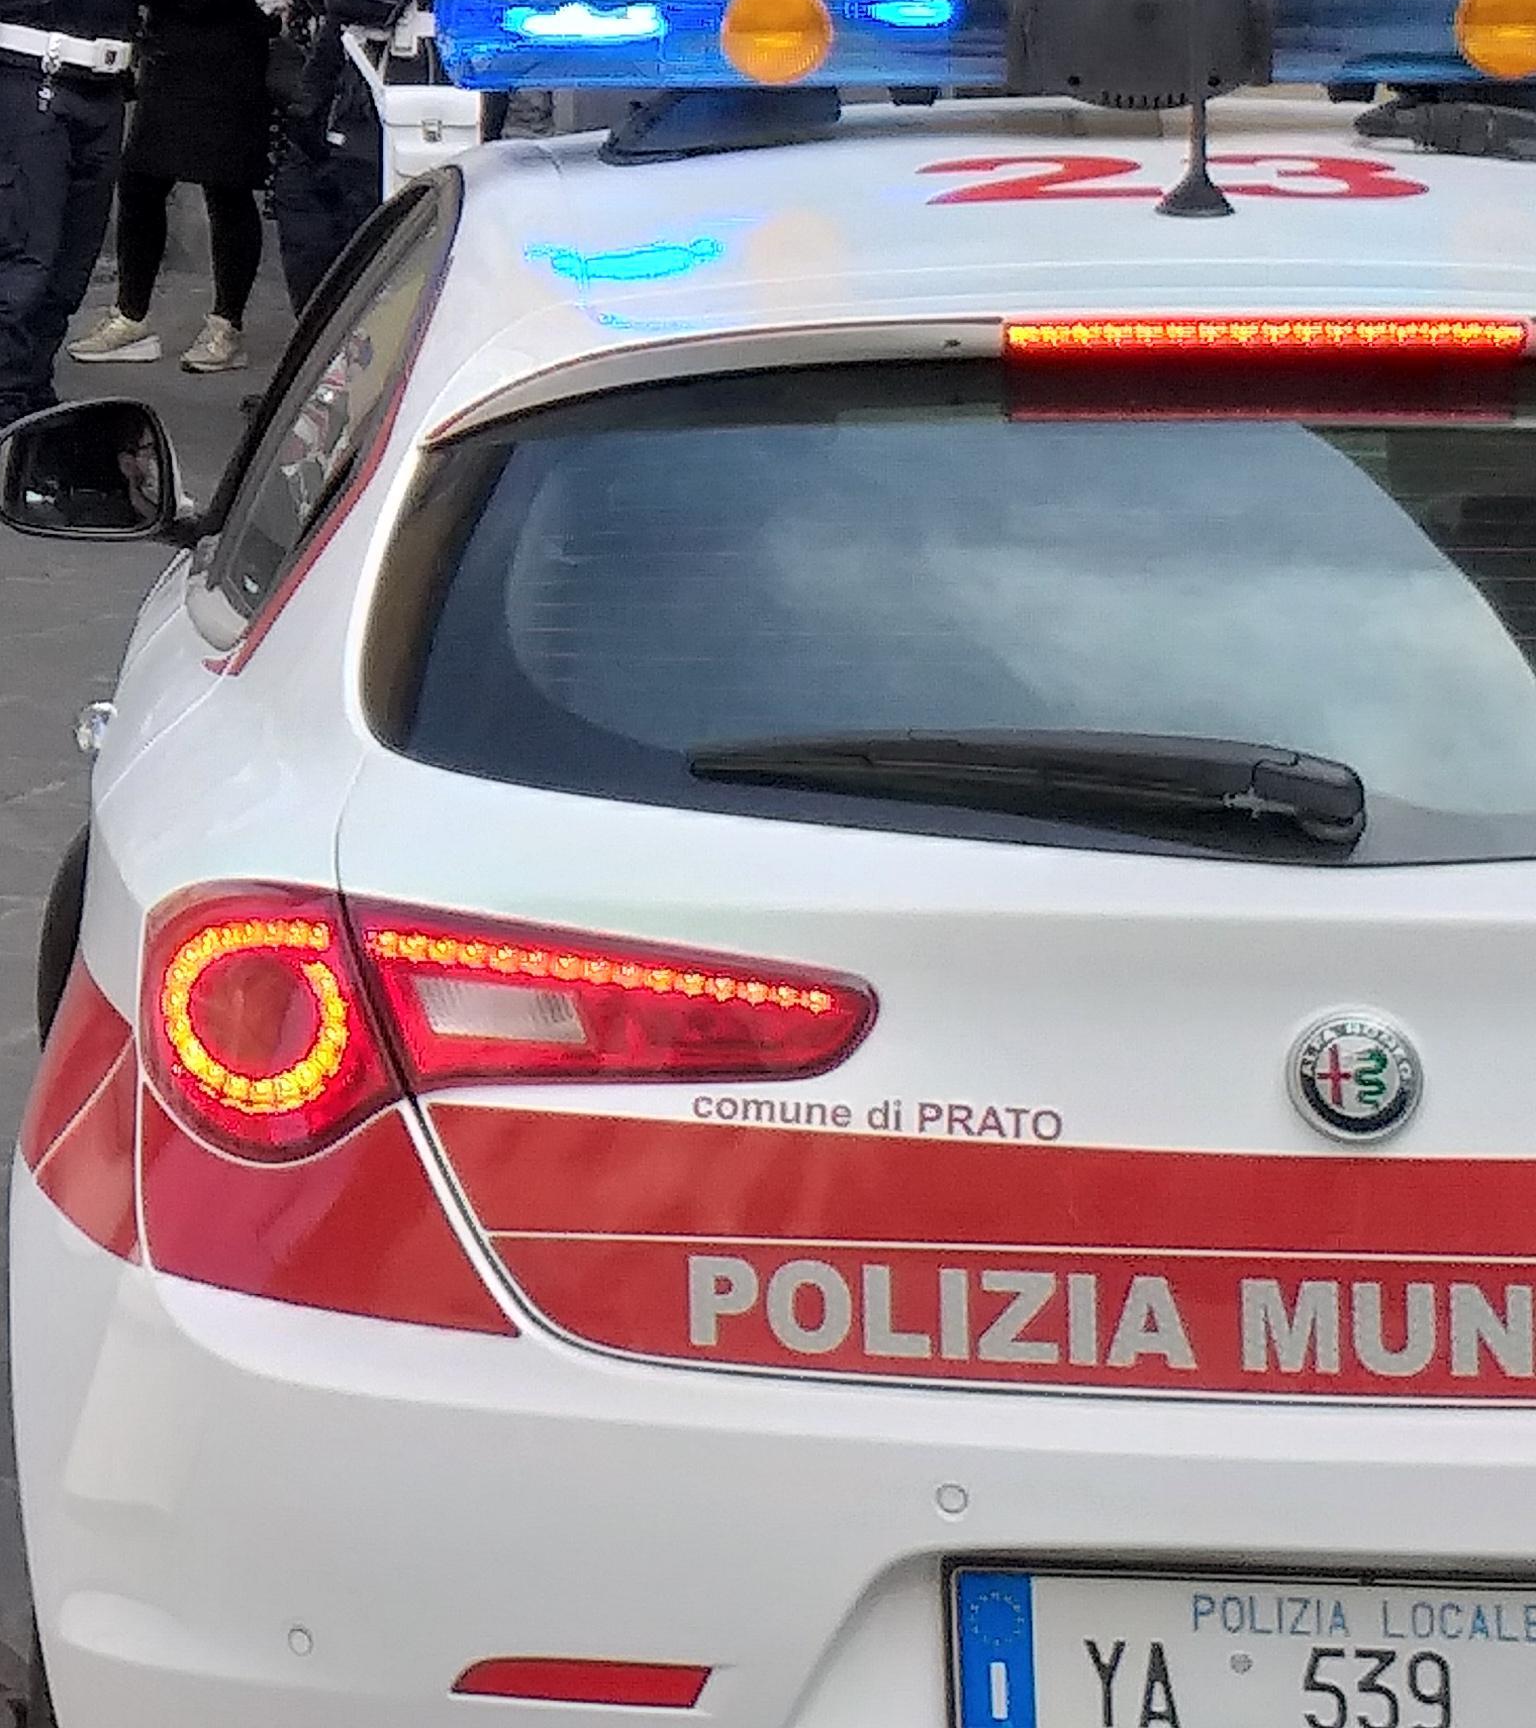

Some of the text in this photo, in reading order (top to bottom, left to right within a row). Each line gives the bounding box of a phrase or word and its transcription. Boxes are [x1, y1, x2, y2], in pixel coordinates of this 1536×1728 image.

[691, 1092, 1064, 1142] comune di PRATO
[686, 1255, 1197, 1370] POLIZIA
[1191, 1593, 1351, 1639] POLIZIA
[1084, 1638, 1452, 1728] YA 539
